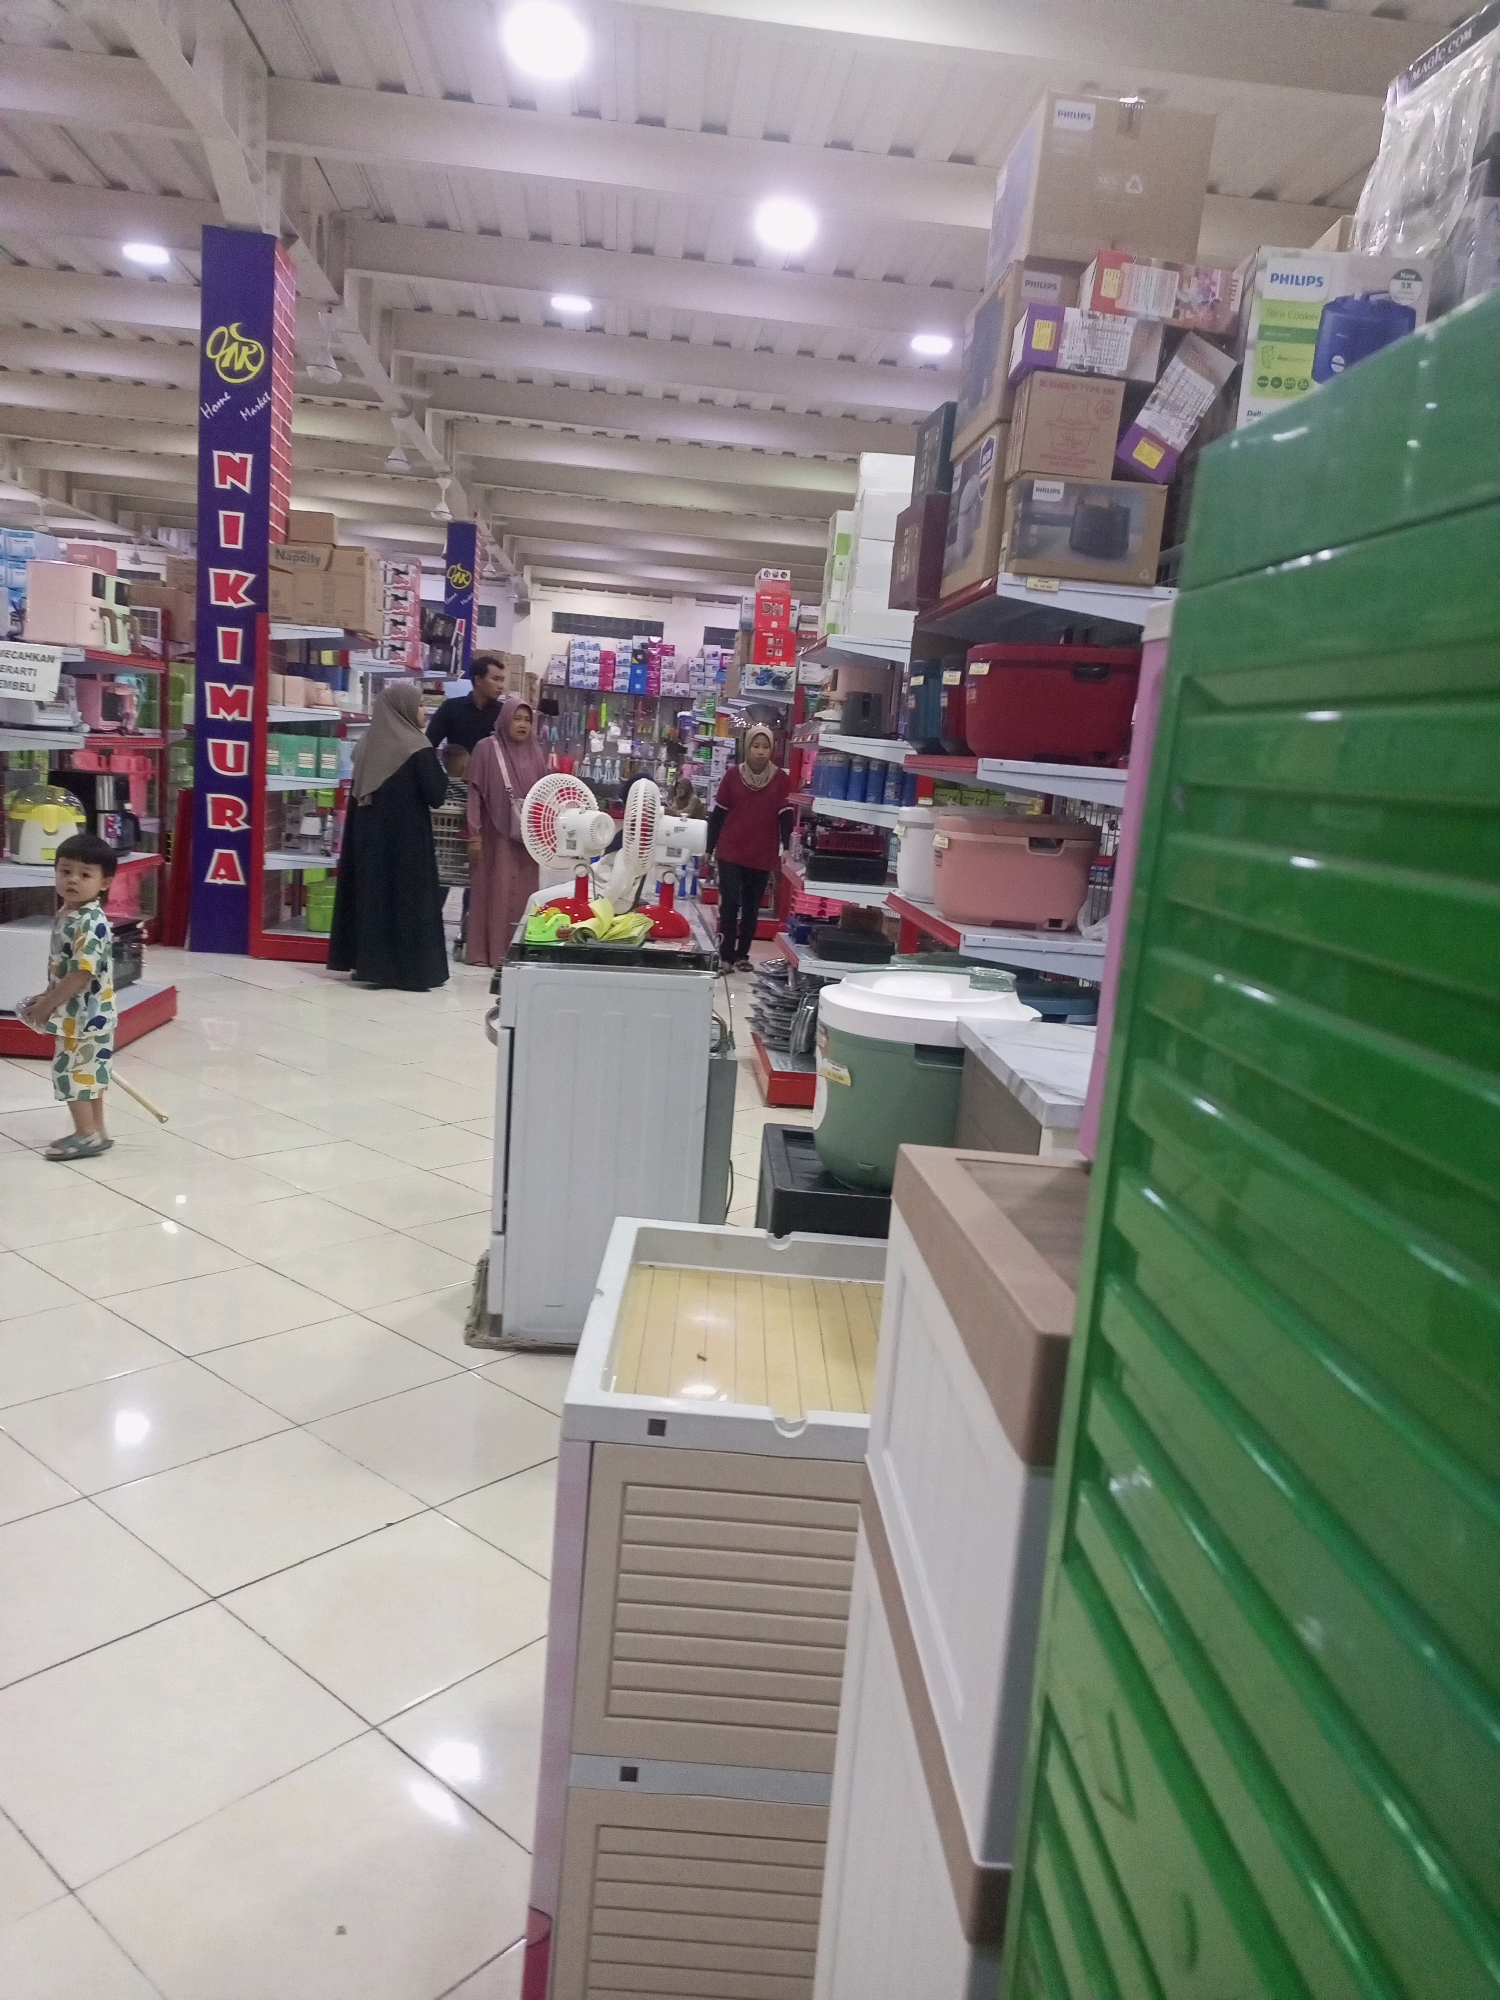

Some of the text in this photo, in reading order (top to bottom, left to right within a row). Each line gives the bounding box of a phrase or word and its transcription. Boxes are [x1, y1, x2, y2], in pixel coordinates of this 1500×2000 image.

[1057, 109, 1091, 121] PHILIPS
[1025, 279, 1058, 290] PHILIPS
[1269, 272, 1324, 288] PHILIPS
[200, 391, 231, 419] Home
[239, 390, 271, 422] Market
[1035, 486, 1061, 495] PHILIPS
[204, 450, 256, 886] NIKIMURA
